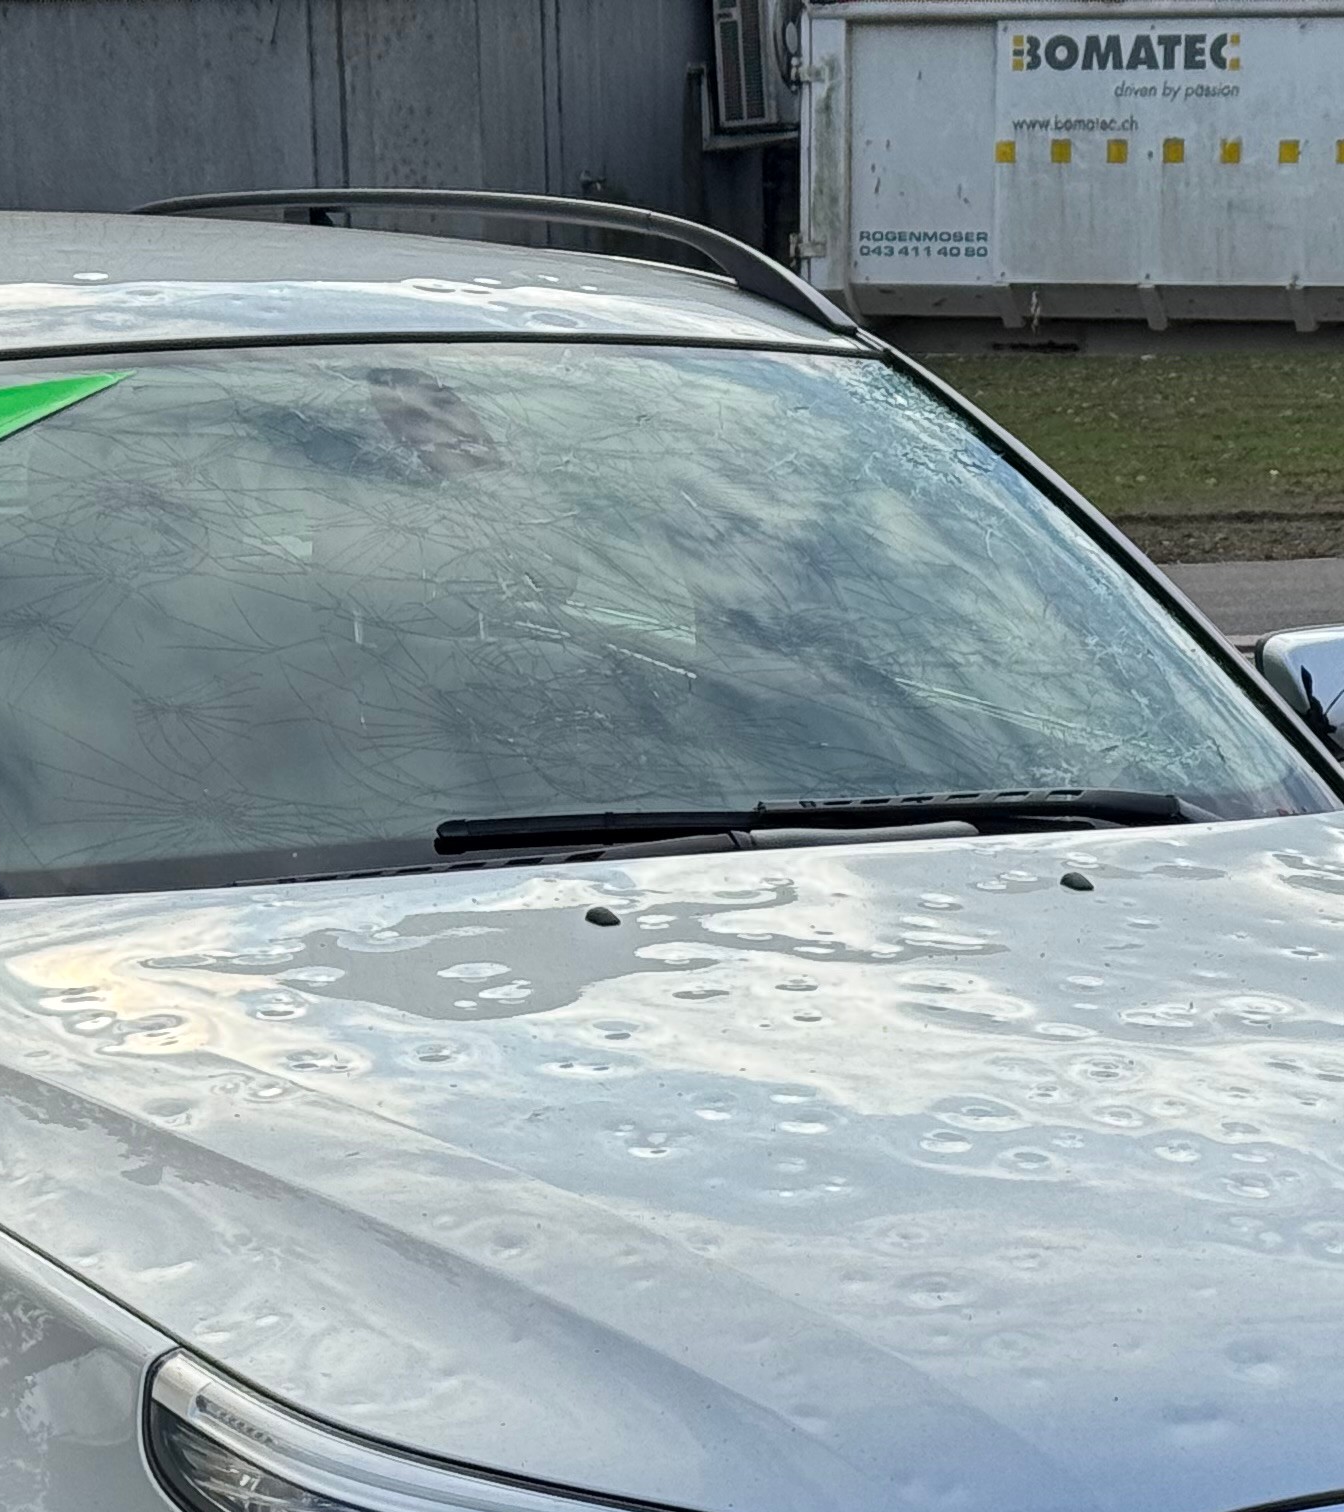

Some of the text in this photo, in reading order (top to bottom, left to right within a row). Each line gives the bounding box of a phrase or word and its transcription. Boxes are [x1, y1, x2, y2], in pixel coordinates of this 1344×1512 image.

[1012, 33, 1241, 71] BOMATEC
[1114, 80, 1240, 102] driven by passion
[1012, 115, 1139, 131] www.bomatec.ch
[859, 230, 989, 243] ROGENMOSER
